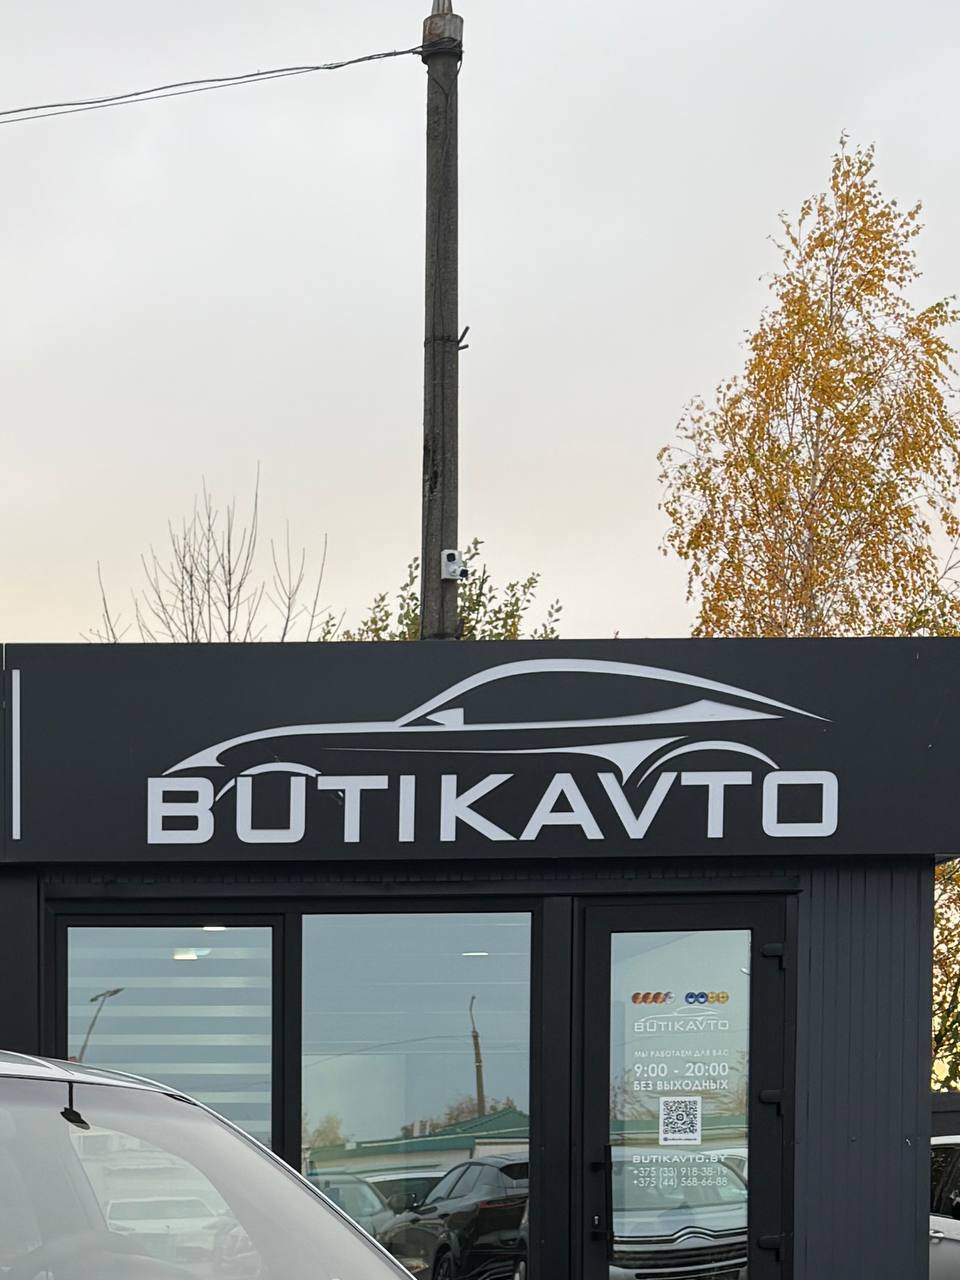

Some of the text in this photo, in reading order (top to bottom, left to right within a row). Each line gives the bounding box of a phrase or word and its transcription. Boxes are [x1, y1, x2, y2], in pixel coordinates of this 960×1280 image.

[147, 770, 839, 844] BUTIKAVTO
[634, 1020, 729, 1032] BUTIKAVTO
[634, 1063, 668, 1077] 9:00
[685, 1062, 729, 1076] 20:00
[633, 1080, 728, 1090] БЕЗ ВЫХОДНЫХ
[632, 1154, 727, 1163] BUTIKAVTO.BY
[633, 1167, 656, 1177] +375
[659, 1167, 677, 1179] (33)
[633, 1177, 656, 1187] +375
[659, 1177, 677, 1189] (44)
